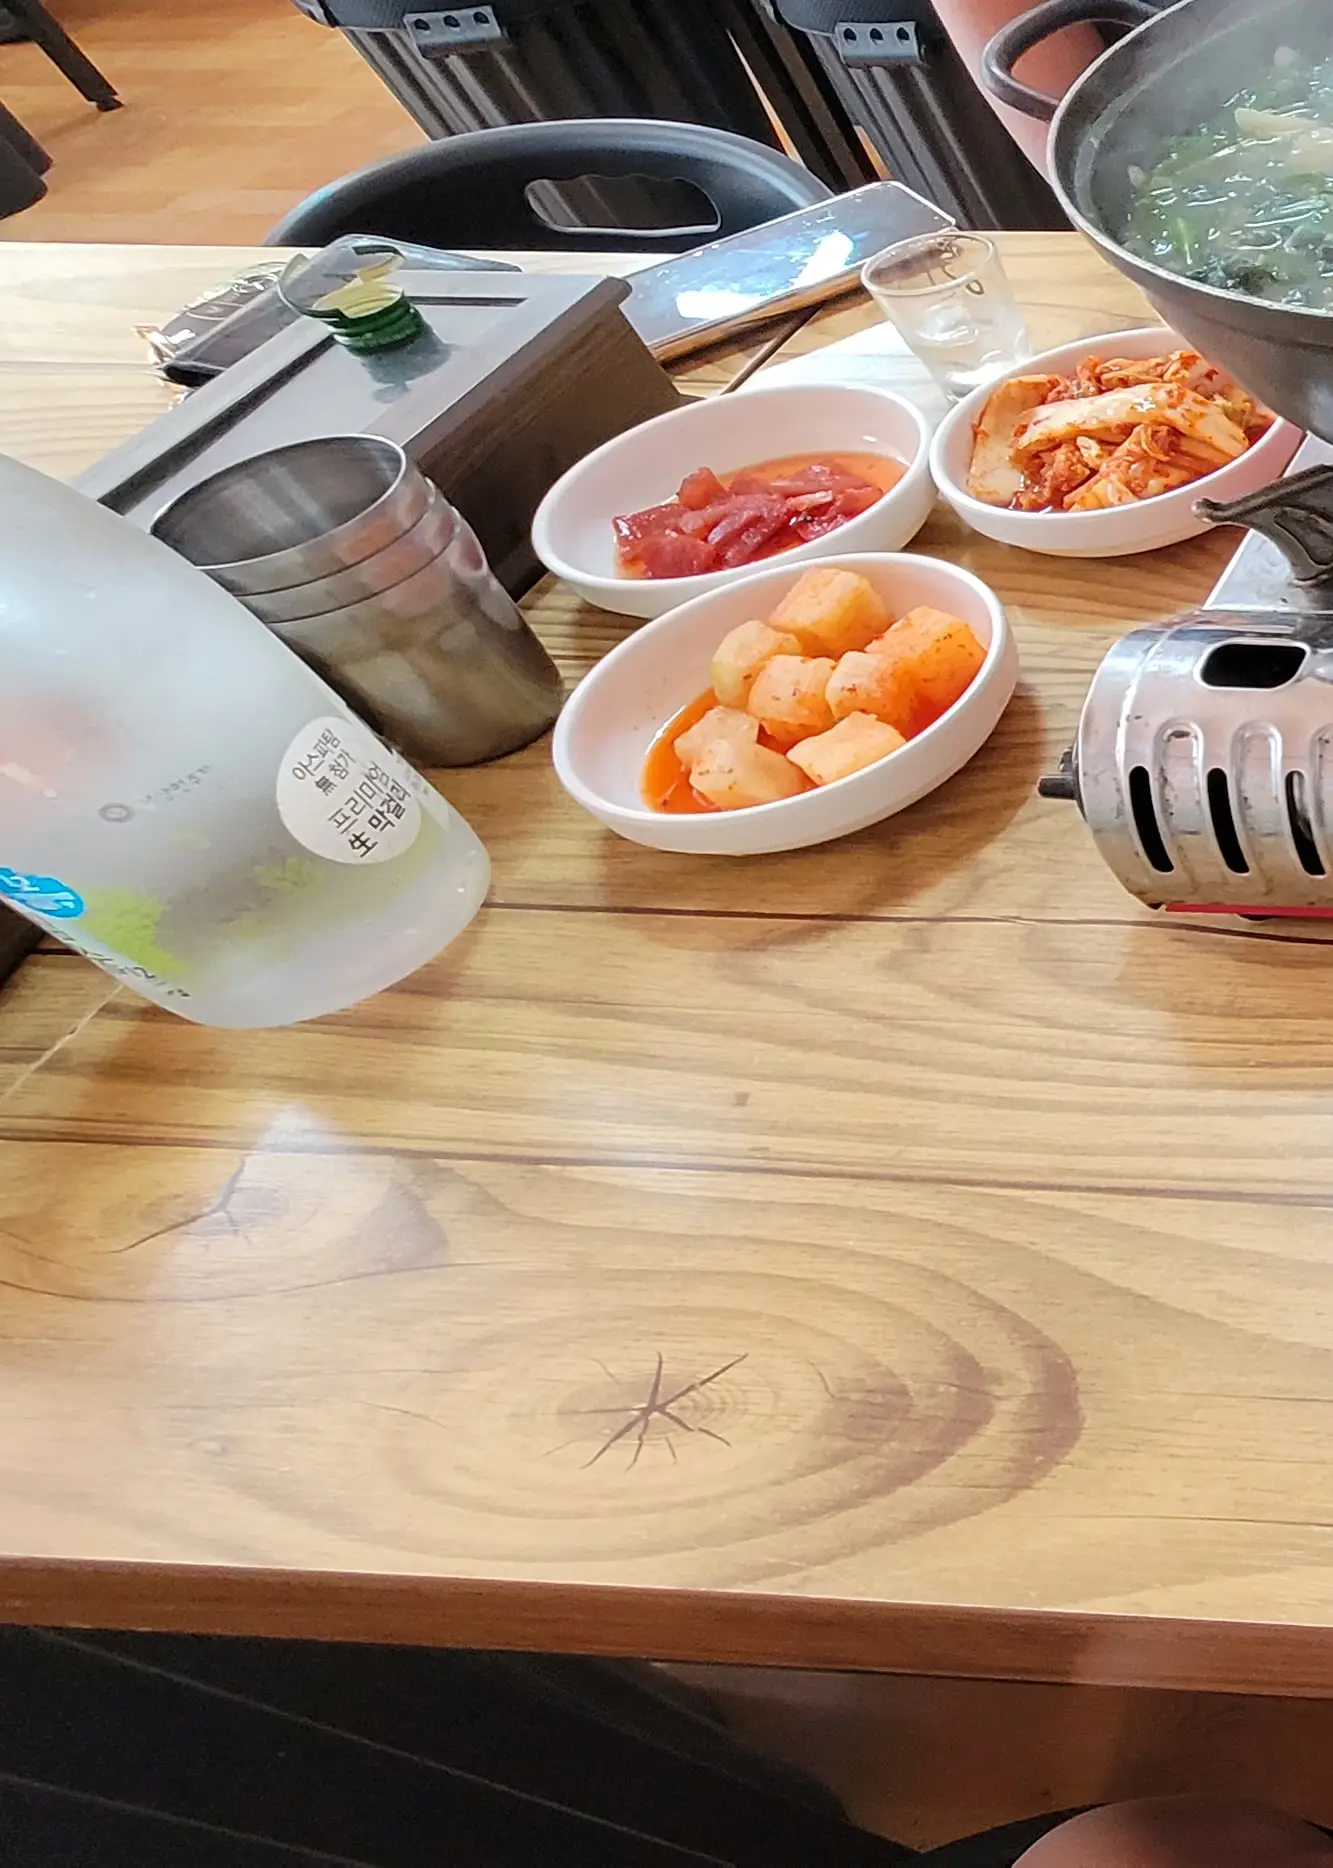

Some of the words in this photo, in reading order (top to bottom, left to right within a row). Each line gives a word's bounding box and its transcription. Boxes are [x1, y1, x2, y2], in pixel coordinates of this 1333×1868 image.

[291, 727, 341, 781] 아스파탐
[315, 775, 338, 797] 無
[328, 748, 356, 780] 첨가
[327, 760, 390, 835] 프리미엄
[348, 831, 379, 858] 生
[367, 778, 412, 842] 막걸리
